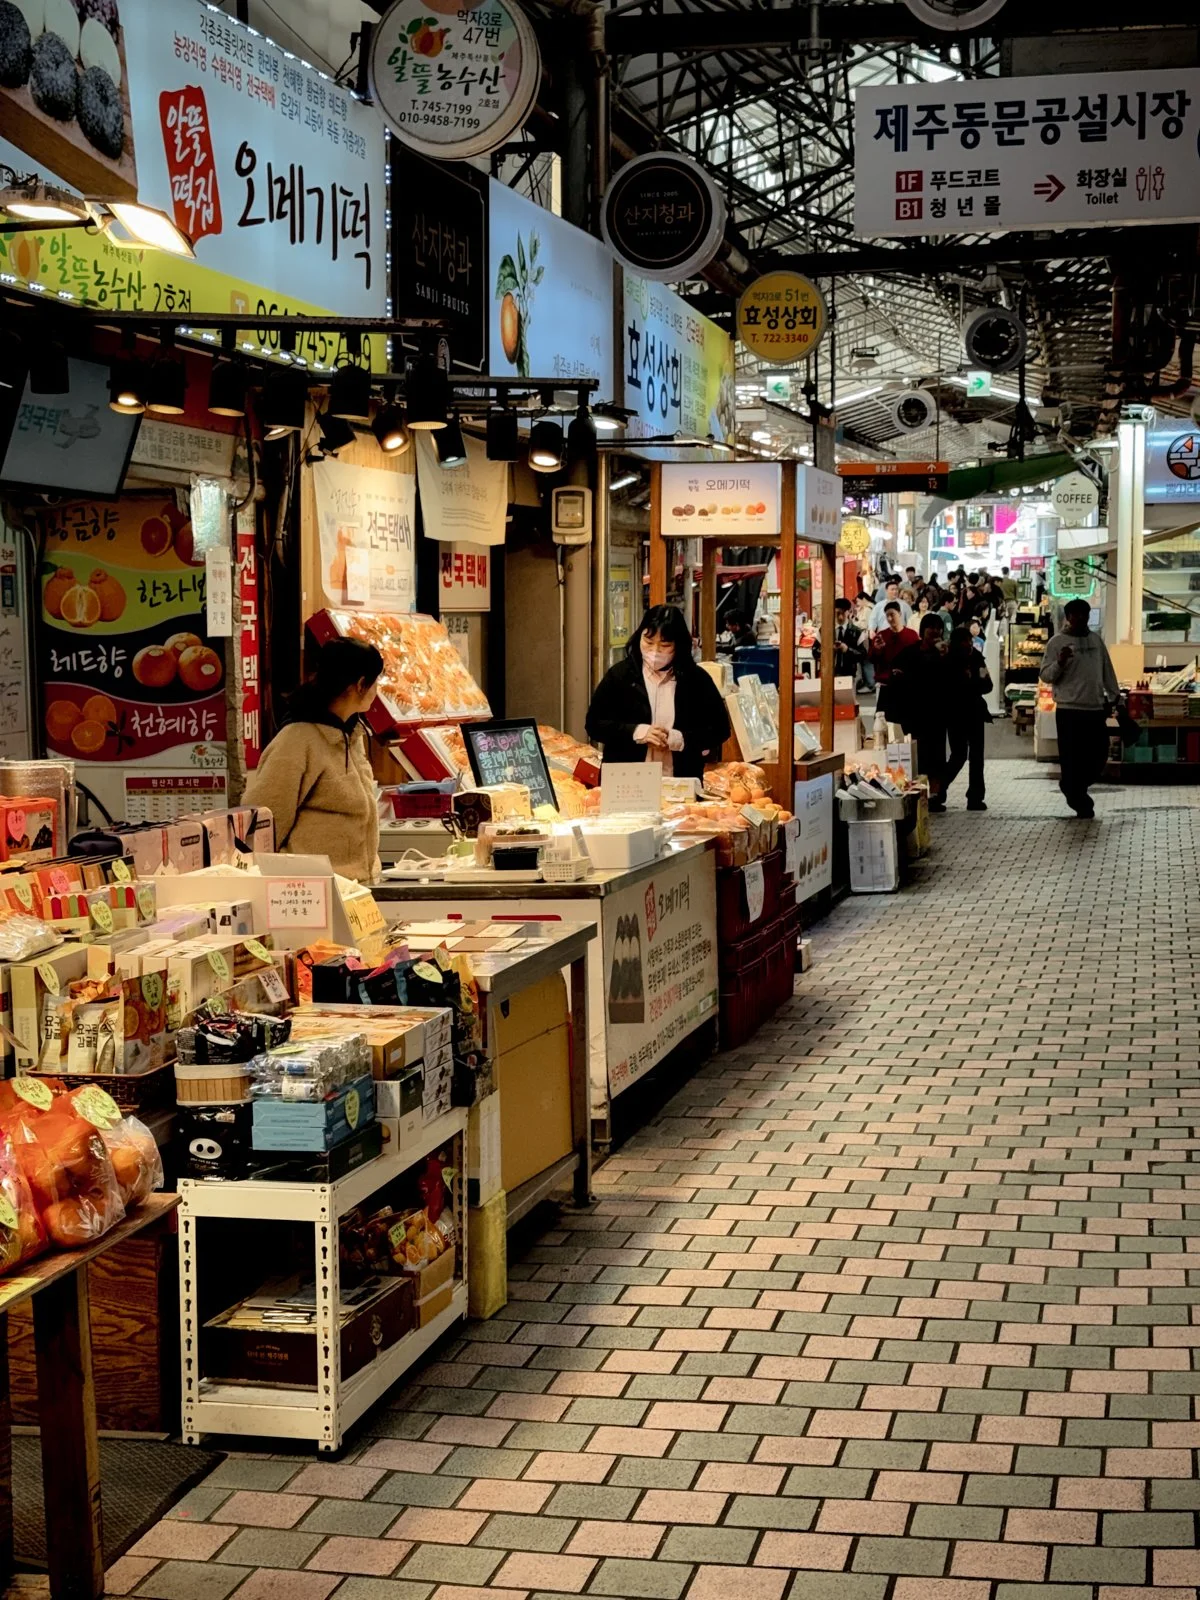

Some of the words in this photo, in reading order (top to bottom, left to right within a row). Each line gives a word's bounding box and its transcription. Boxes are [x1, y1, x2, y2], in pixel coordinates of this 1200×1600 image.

[457, 10, 503, 26] 먹자3로
[200, 14, 254, 68] 각종초콜릿전문
[258, 49, 279, 82] 한라봉
[463, 27, 501, 48] 47번
[173, 30, 207, 72] 농장직영
[211, 52, 242, 92] 수협직영
[246, 73, 276, 110] 전국택배
[387, 47, 506, 96] 알뜰농수산
[421, 101, 473, 115] 745-7199
[478, 99, 500, 109] 2호점
[166, 95, 207, 167] 알뜰
[399, 112, 481, 129] 010-9458-7199
[873, 89, 1192, 153] 제주동문공설시장
[898, 173, 919, 191] 1F
[929, 168, 1001, 191] 푸드코트
[1076, 167, 1128, 189] 화장실
[171, 166, 215, 235] 떡집
[899, 200, 920, 218] B1
[1085, 192, 1119, 206] Toilet
[234, 140, 373, 290] 오메기떡
[623, 202, 696, 226] 산지청과
[411, 213, 473, 287] 산지청과
[442, 293, 470, 316] FRUITS
[742, 305, 818, 330] 효성상회
[763, 333, 809, 344] 722-3340
[626, 319, 683, 426] 효성상회
[705, 478, 751, 492] 오메기떡
[1056, 493, 1093, 504] COFFEE
[367, 511, 412, 553] 전국택배
[441, 552, 488, 589] 전국택배
[50, 644, 127, 678] 레드향
[131, 705, 219, 742] 천혜향
[151, 778, 174, 788] 원산지
[177, 777, 200, 788] 표시판
